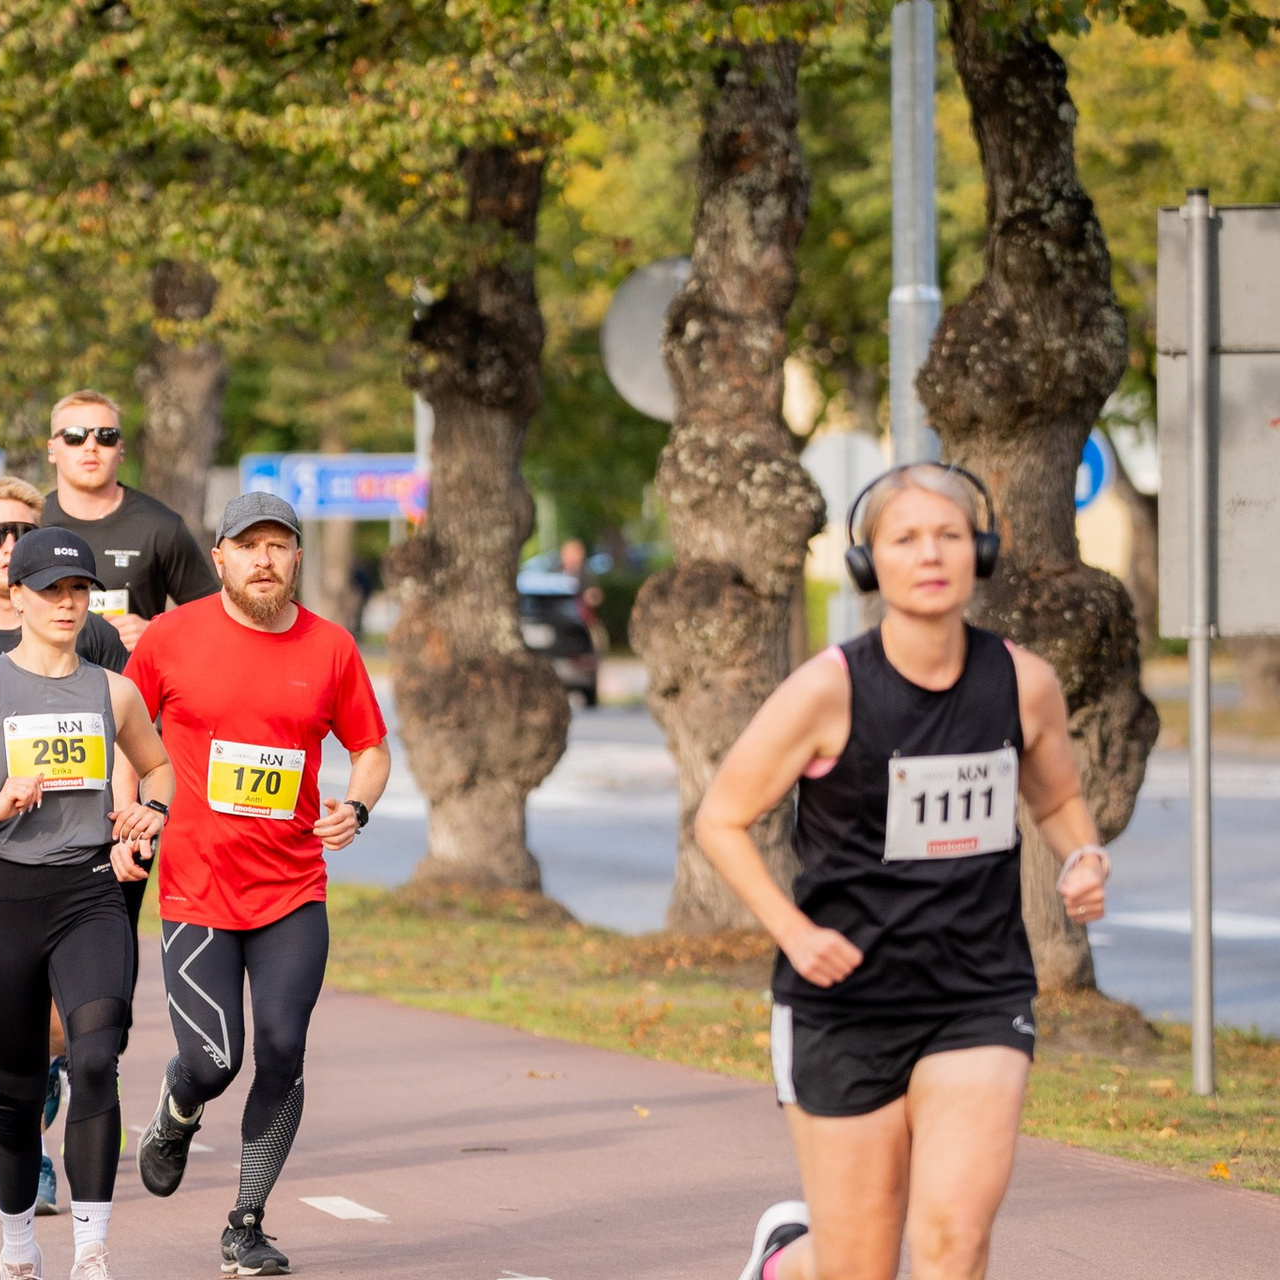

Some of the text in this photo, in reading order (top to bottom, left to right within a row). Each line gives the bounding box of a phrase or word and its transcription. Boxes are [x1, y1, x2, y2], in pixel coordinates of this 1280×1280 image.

[54, 547, 79, 557] BOSS
[32, 738, 86, 766] 295
[43, 777, 83, 788] motonet
[233, 766, 282, 795] 170
[245, 795, 263, 803] Antti
[911, 785, 993, 824] 1111
[234, 803, 271, 815] motonet
